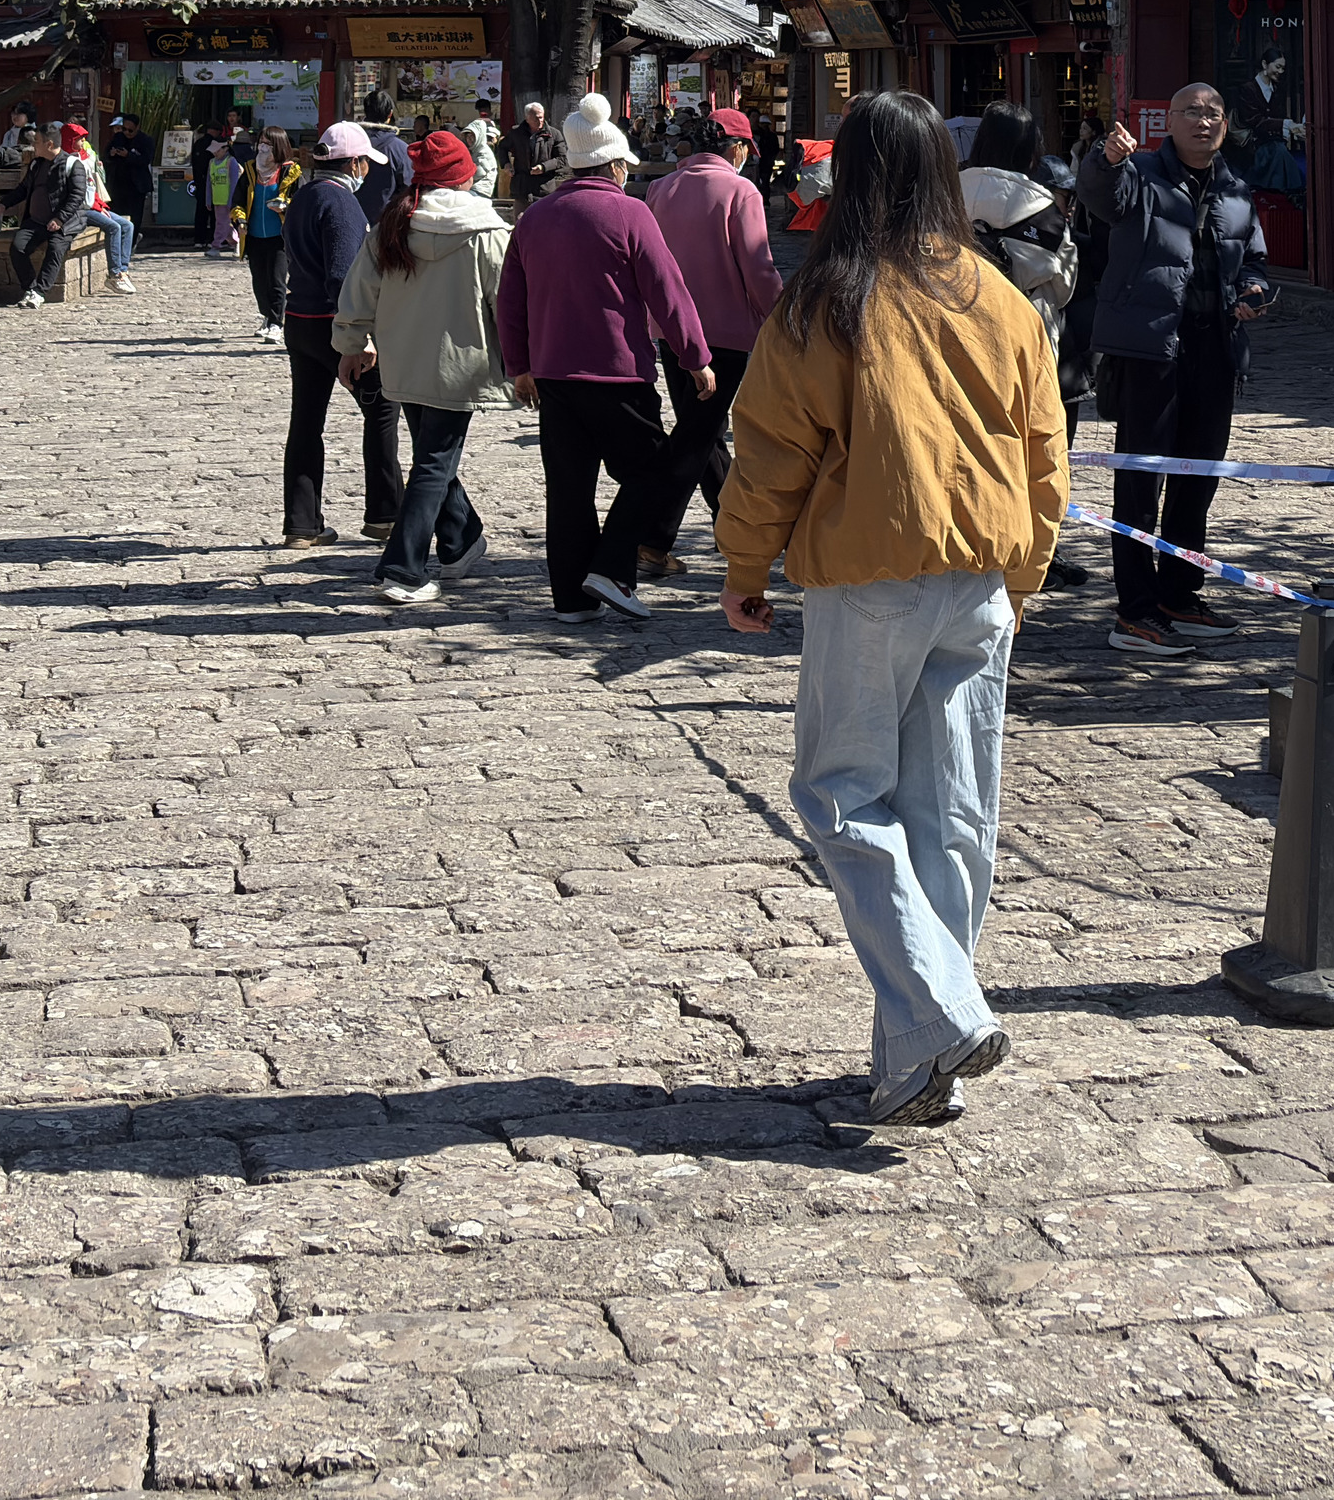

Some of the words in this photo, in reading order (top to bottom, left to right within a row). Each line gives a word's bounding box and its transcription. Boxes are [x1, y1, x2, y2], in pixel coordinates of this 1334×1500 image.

[1260, 16, 1305, 29] HON
[210, 34, 270, 50] 椰一族
[386, 31, 475, 44] 意大利冰淇淋
[394, 44, 439, 52] GELATERIA
[444, 44, 470, 52] ITALIA
